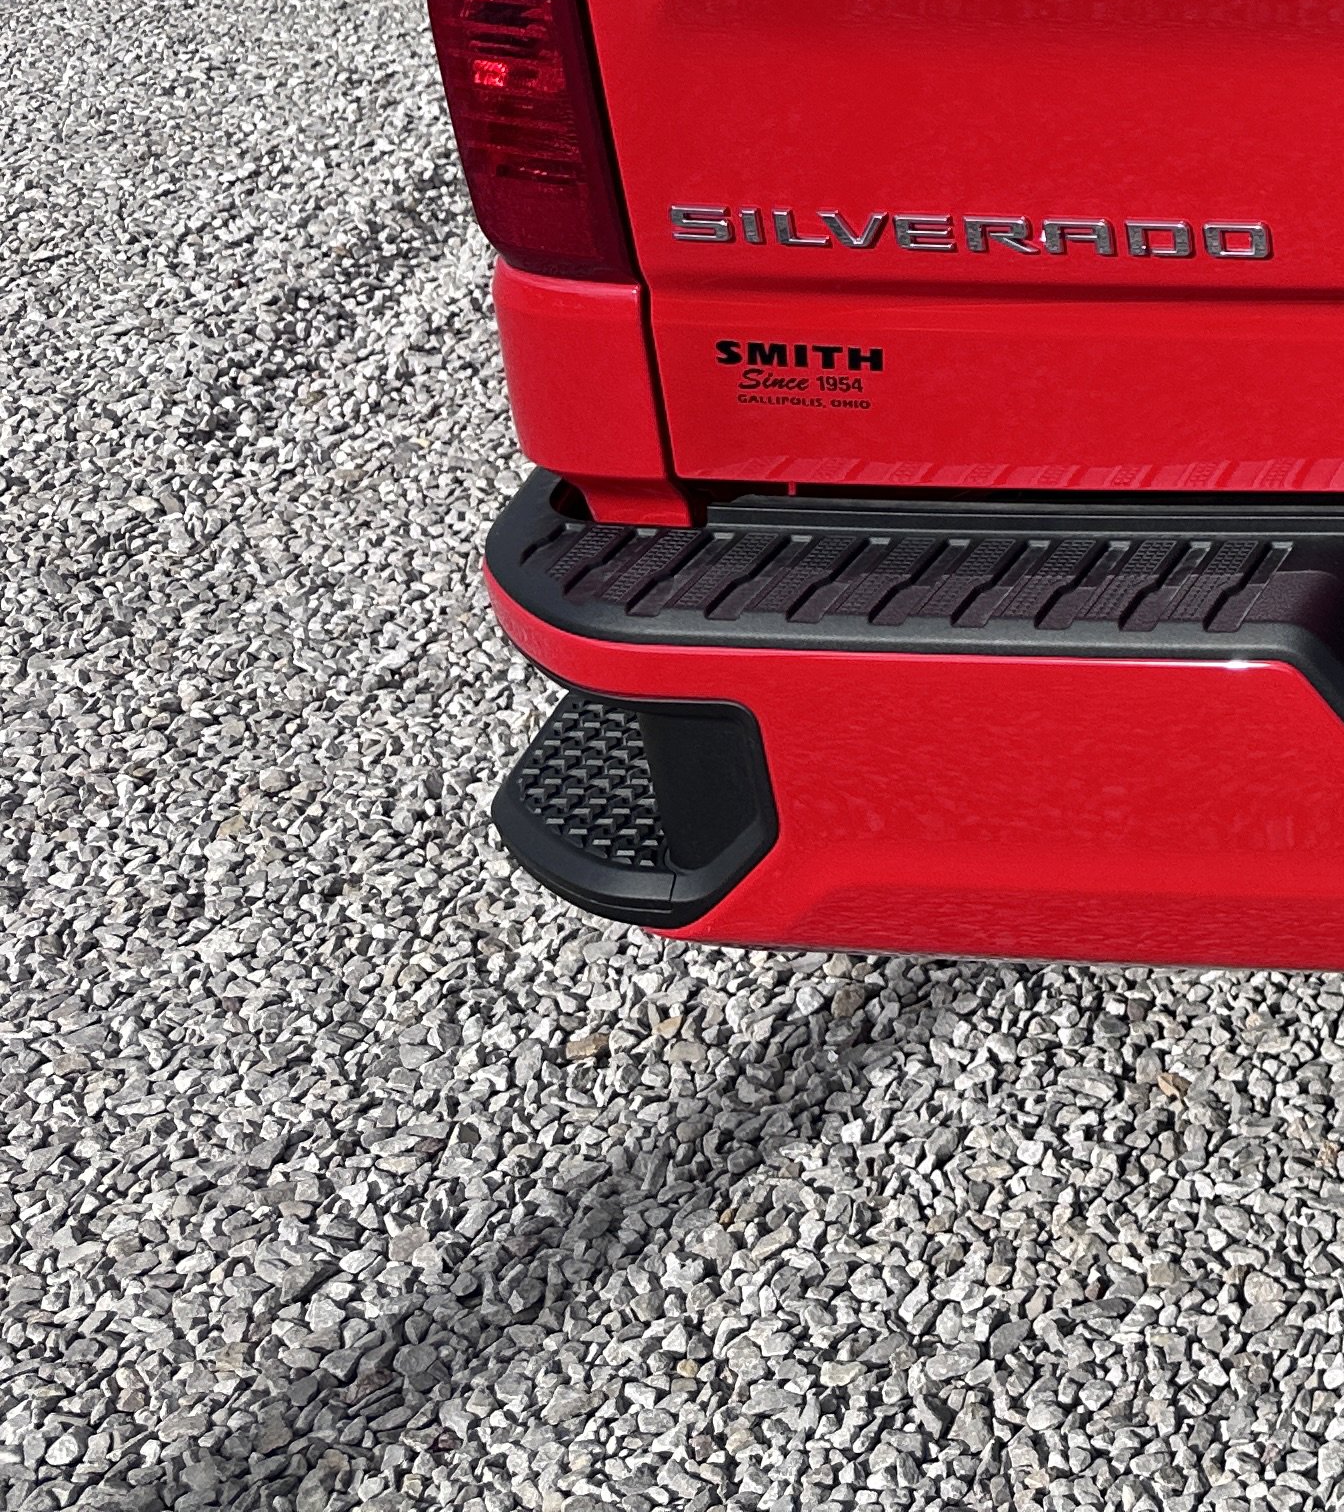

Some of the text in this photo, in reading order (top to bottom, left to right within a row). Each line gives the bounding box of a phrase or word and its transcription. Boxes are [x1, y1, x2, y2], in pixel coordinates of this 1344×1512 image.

[668, 203, 1275, 260] SILVERADO
[715, 340, 884, 371] SMITH
[738, 368, 863, 393] Since 1954
[830, 398, 871, 410] OHIO
